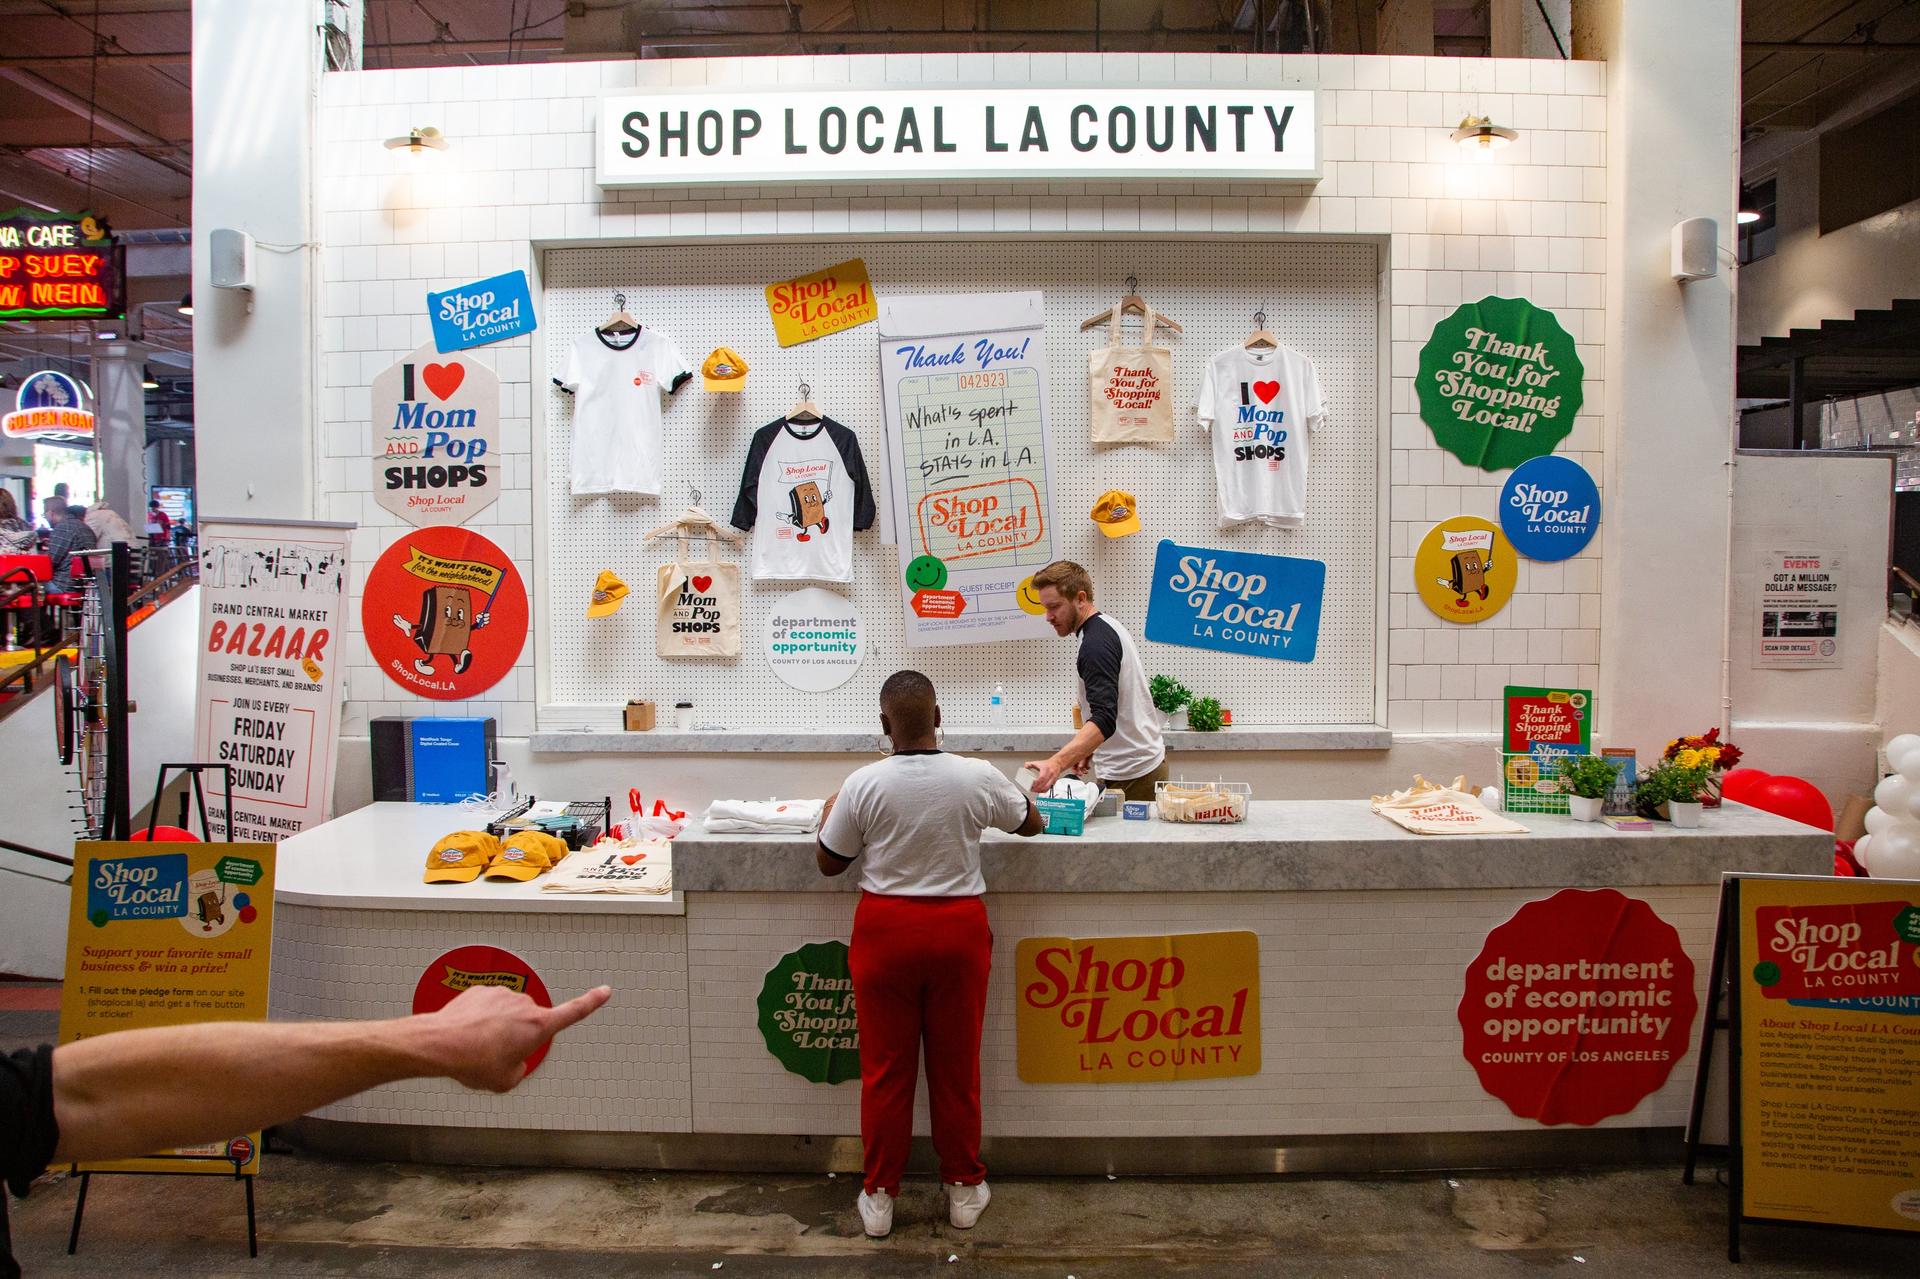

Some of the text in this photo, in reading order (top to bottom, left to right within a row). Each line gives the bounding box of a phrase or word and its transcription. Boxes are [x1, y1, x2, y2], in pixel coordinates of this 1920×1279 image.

[620, 102, 1296, 159] SHOP LOCAL LA COUNTY
[27, 226, 74, 246] CAFE
[24, 254, 101, 278] SUEY
[31, 282, 101, 305] MEIN
[772, 277, 837, 314] Shop
[789, 283, 868, 325] Local
[439, 291, 495, 320] Shop
[453, 299, 520, 331] Local
[462, 319, 521, 342] LA COUNTY
[802, 307, 870, 336] LA COUNTY
[896, 337, 1030, 370] Thank You!
[1464, 327, 1554, 371] Thank
[1113, 366, 1156, 380] Thank
[1452, 351, 1561, 388] You for
[403, 364, 415, 401] I
[960, 372, 1005, 389] 042923
[1110, 378, 1159, 390] You for
[1104, 388, 1161, 400] Shopping
[1240, 382, 1249, 405] I
[1435, 370, 1560, 418] Shopping
[906, 400, 1018, 428] What's spent
[1113, 400, 1153, 409] Local!
[1237, 404, 1284, 424] Mom
[392, 402, 477, 430] Mom
[1452, 400, 1538, 433] Local!
[945, 428, 999, 450] in L.A.
[1234, 423, 1288, 446] AND Pop
[386, 432, 487, 463] AND Pop
[980, 453, 996, 468] in
[1003, 447, 1036, 467] L.A.
[1234, 445, 1285, 461] SHOPS
[384, 464, 487, 489] SHOPS
[786, 464, 827, 476] Shop Local
[407, 494, 465, 508] Shop Local
[1510, 484, 1568, 508] Shop
[930, 496, 998, 527] Shop
[1522, 505, 1590, 524] Local
[947, 505, 1027, 540] Local
[1527, 524, 1587, 534] LA COUNTY
[957, 531, 1028, 551] LA COUNTY
[1449, 533, 1488, 543] Shop Local
[411, 562, 426, 573] for
[426, 566, 438, 575] the
[417, 554, 493, 577] IT'S WHAT'S GOOD
[1783, 560, 1820, 569] EVENTS
[959, 581, 1015, 593] GUEST RECEIPT
[1169, 555, 1267, 601] Shop
[1765, 584, 1838, 592] DOLLAR MESSAGE?
[1773, 573, 1830, 582] GOT A MILLION
[677, 593, 717, 606] Mom
[212, 602, 328, 622] GRAND CENTRAL MARKET
[691, 606, 721, 622] Pop
[1187, 589, 1302, 632] Local
[672, 622, 721, 633] SHOPS
[772, 616, 857, 629] department
[208, 620, 329, 662] BAZAAR
[772, 628, 857, 639] of economic
[1193, 624, 1292, 649] LA COUNTY
[772, 641, 857, 655] opportunity
[230, 663, 246, 672] SHOP
[260, 665, 276, 675] BEST
[276, 667, 295, 677] SMALL
[391, 659, 456, 691] ShopLocal.LA
[244, 677, 281, 689] MERCHANTS,
[282, 681, 294, 690] AND
[295, 682, 323, 692] BRANDS!
[232, 698, 290, 713] JOIN US EVERY
[1523, 704, 1563, 714] Thank
[1515, 722, 1572, 734] Shopping
[1519, 713, 1567, 723] You for
[234, 717, 286, 741] FRIDAY
[1525, 731, 1562, 741] Local!
[219, 741, 295, 768] SATURDAY
[1532, 743, 1569, 755] Shop
[229, 768, 285, 793] SUNDAY
[208, 806, 303, 832] GRAN CENTRAL MARKET
[252, 829, 278, 842] EVENT
[95, 862, 159, 889] Shop
[108, 881, 182, 905] Local
[113, 904, 179, 916] LA COUNTY
[1770, 917, 1861, 953] Shop
[82, 945, 252, 960] Support your favorite small
[1791, 940, 1900, 973] Local
[80, 961, 135, 972] business
[138, 962, 152, 972] &
[155, 963, 178, 973] win
[191, 962, 228, 975] prize!
[1025, 946, 1185, 1009] Shop
[1486, 956, 1674, 988] department
[792, 970, 855, 991] Than
[1804, 972, 1900, 988] LA COUNTY
[88, 987, 194, 998] Fill out the pledge form
[785, 993, 833, 1010] You
[1484, 983, 1672, 1008] of economic
[1060, 987, 1249, 1044] Local
[1483, 1010, 1672, 1042] opportunity
[1760, 1018, 1889, 1034] About Shop Local LA
[1079, 1044, 1243, 1072] LA COUNTY
[1481, 1050, 1670, 1064] COUNTY OF LOS ANGELES
